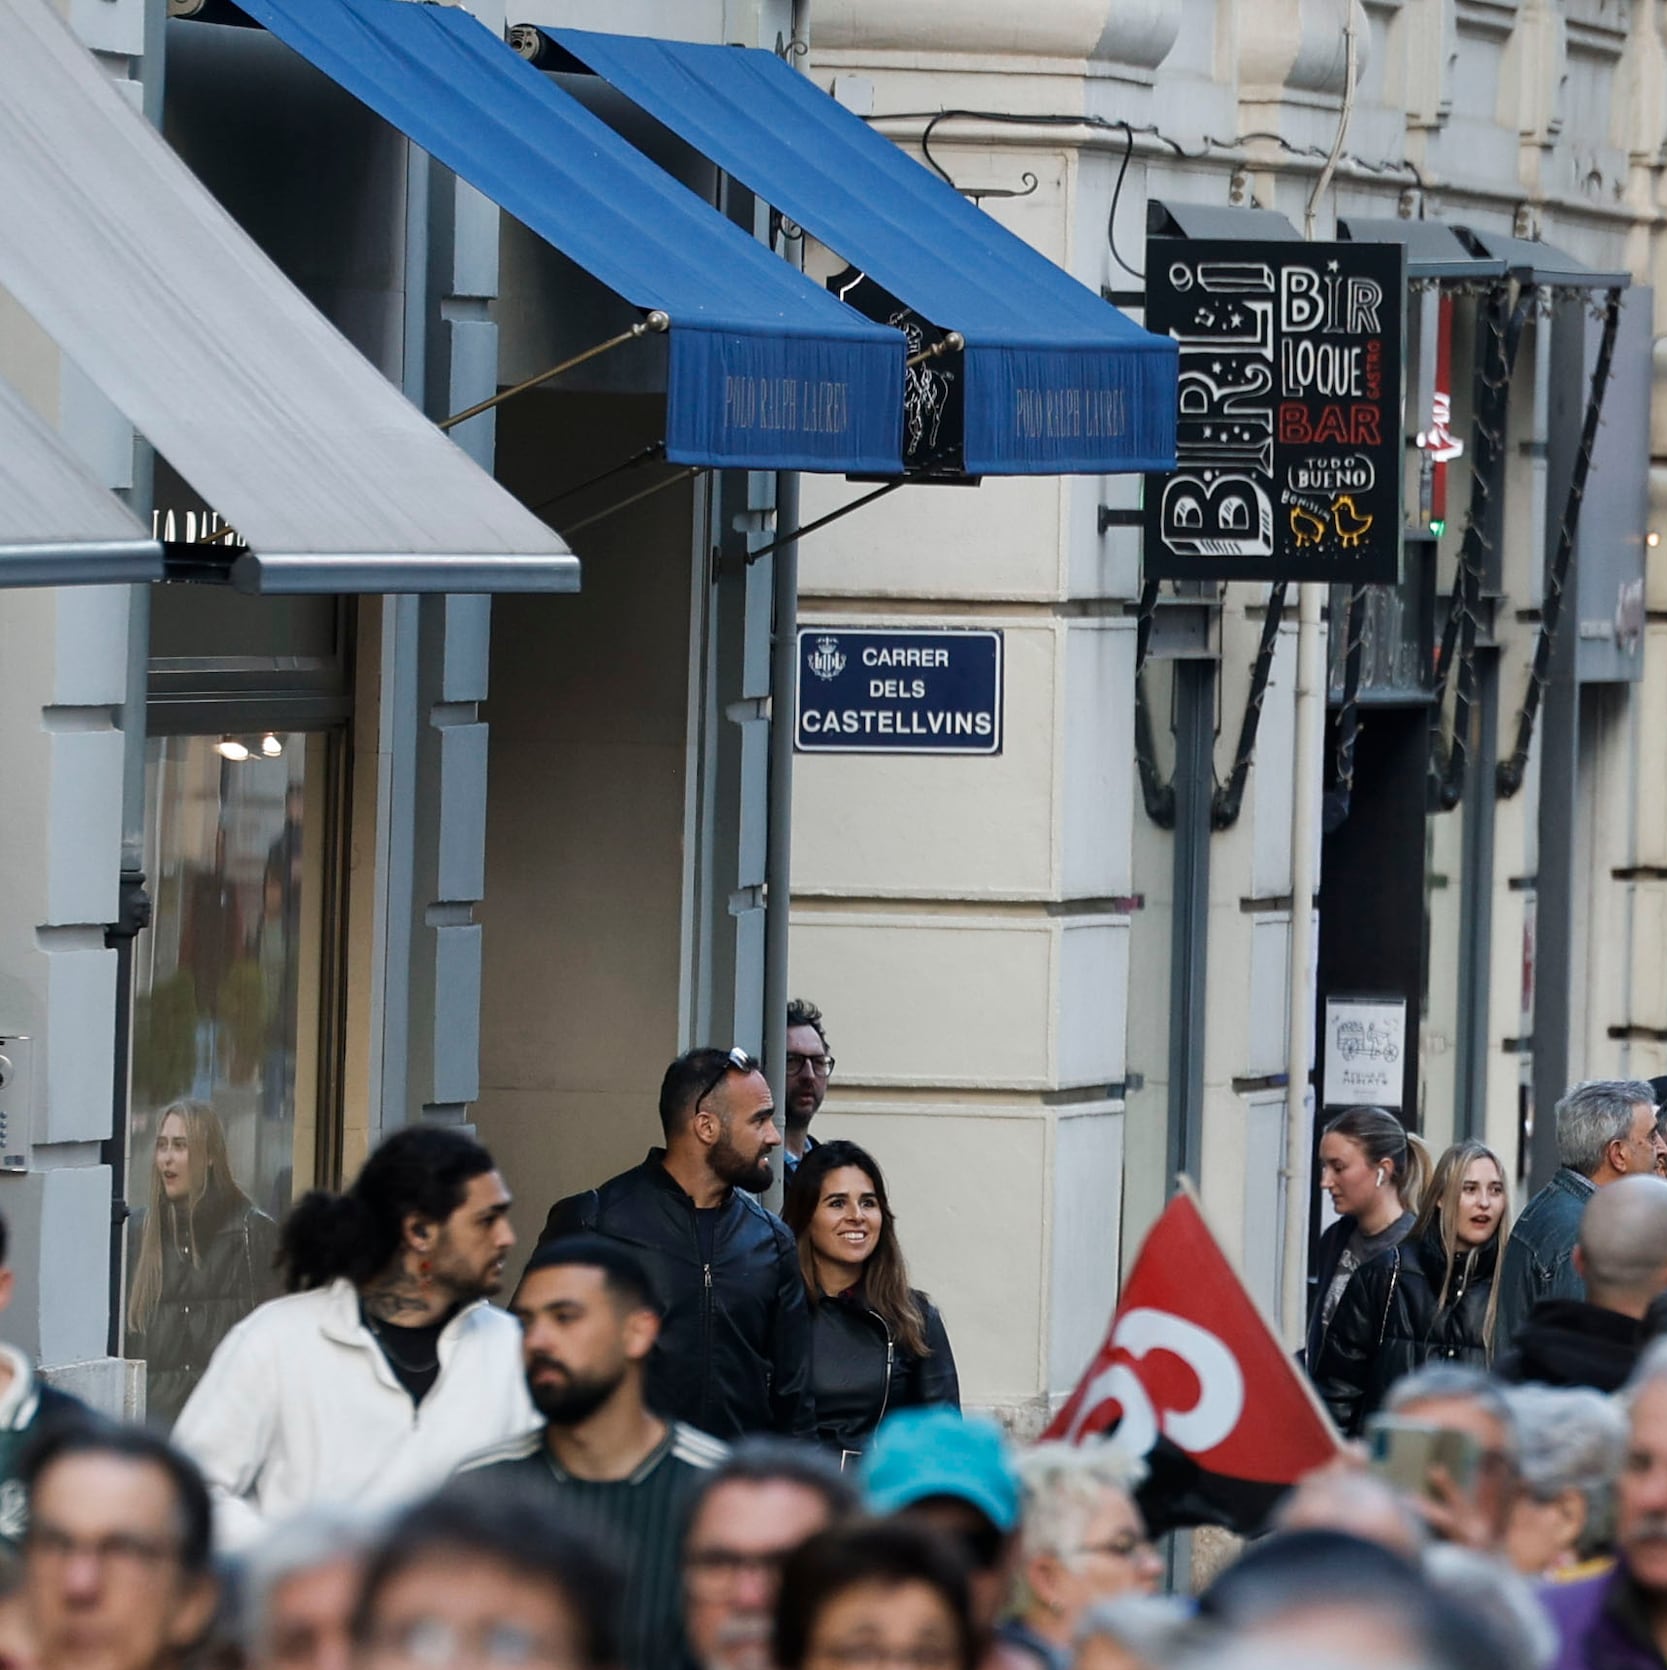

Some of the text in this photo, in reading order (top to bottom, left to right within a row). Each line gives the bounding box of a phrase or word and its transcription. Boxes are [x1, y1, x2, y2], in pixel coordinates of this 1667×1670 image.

[1281, 264, 1382, 334] BIR
[1282, 337, 1362, 397] LOQUE
[725, 376, 755, 429] POLO
[760, 378, 797, 431] RALPH
[1016, 388, 1043, 437] POLO
[1046, 389, 1080, 438] RALPH
[1279, 401, 1381, 445] BAR
[1298, 469, 1366, 489] BUENO
[862, 648, 949, 667] CARRER
[870, 680, 925, 698] DELS
[802, 710, 992, 735] CASTELLVINS
